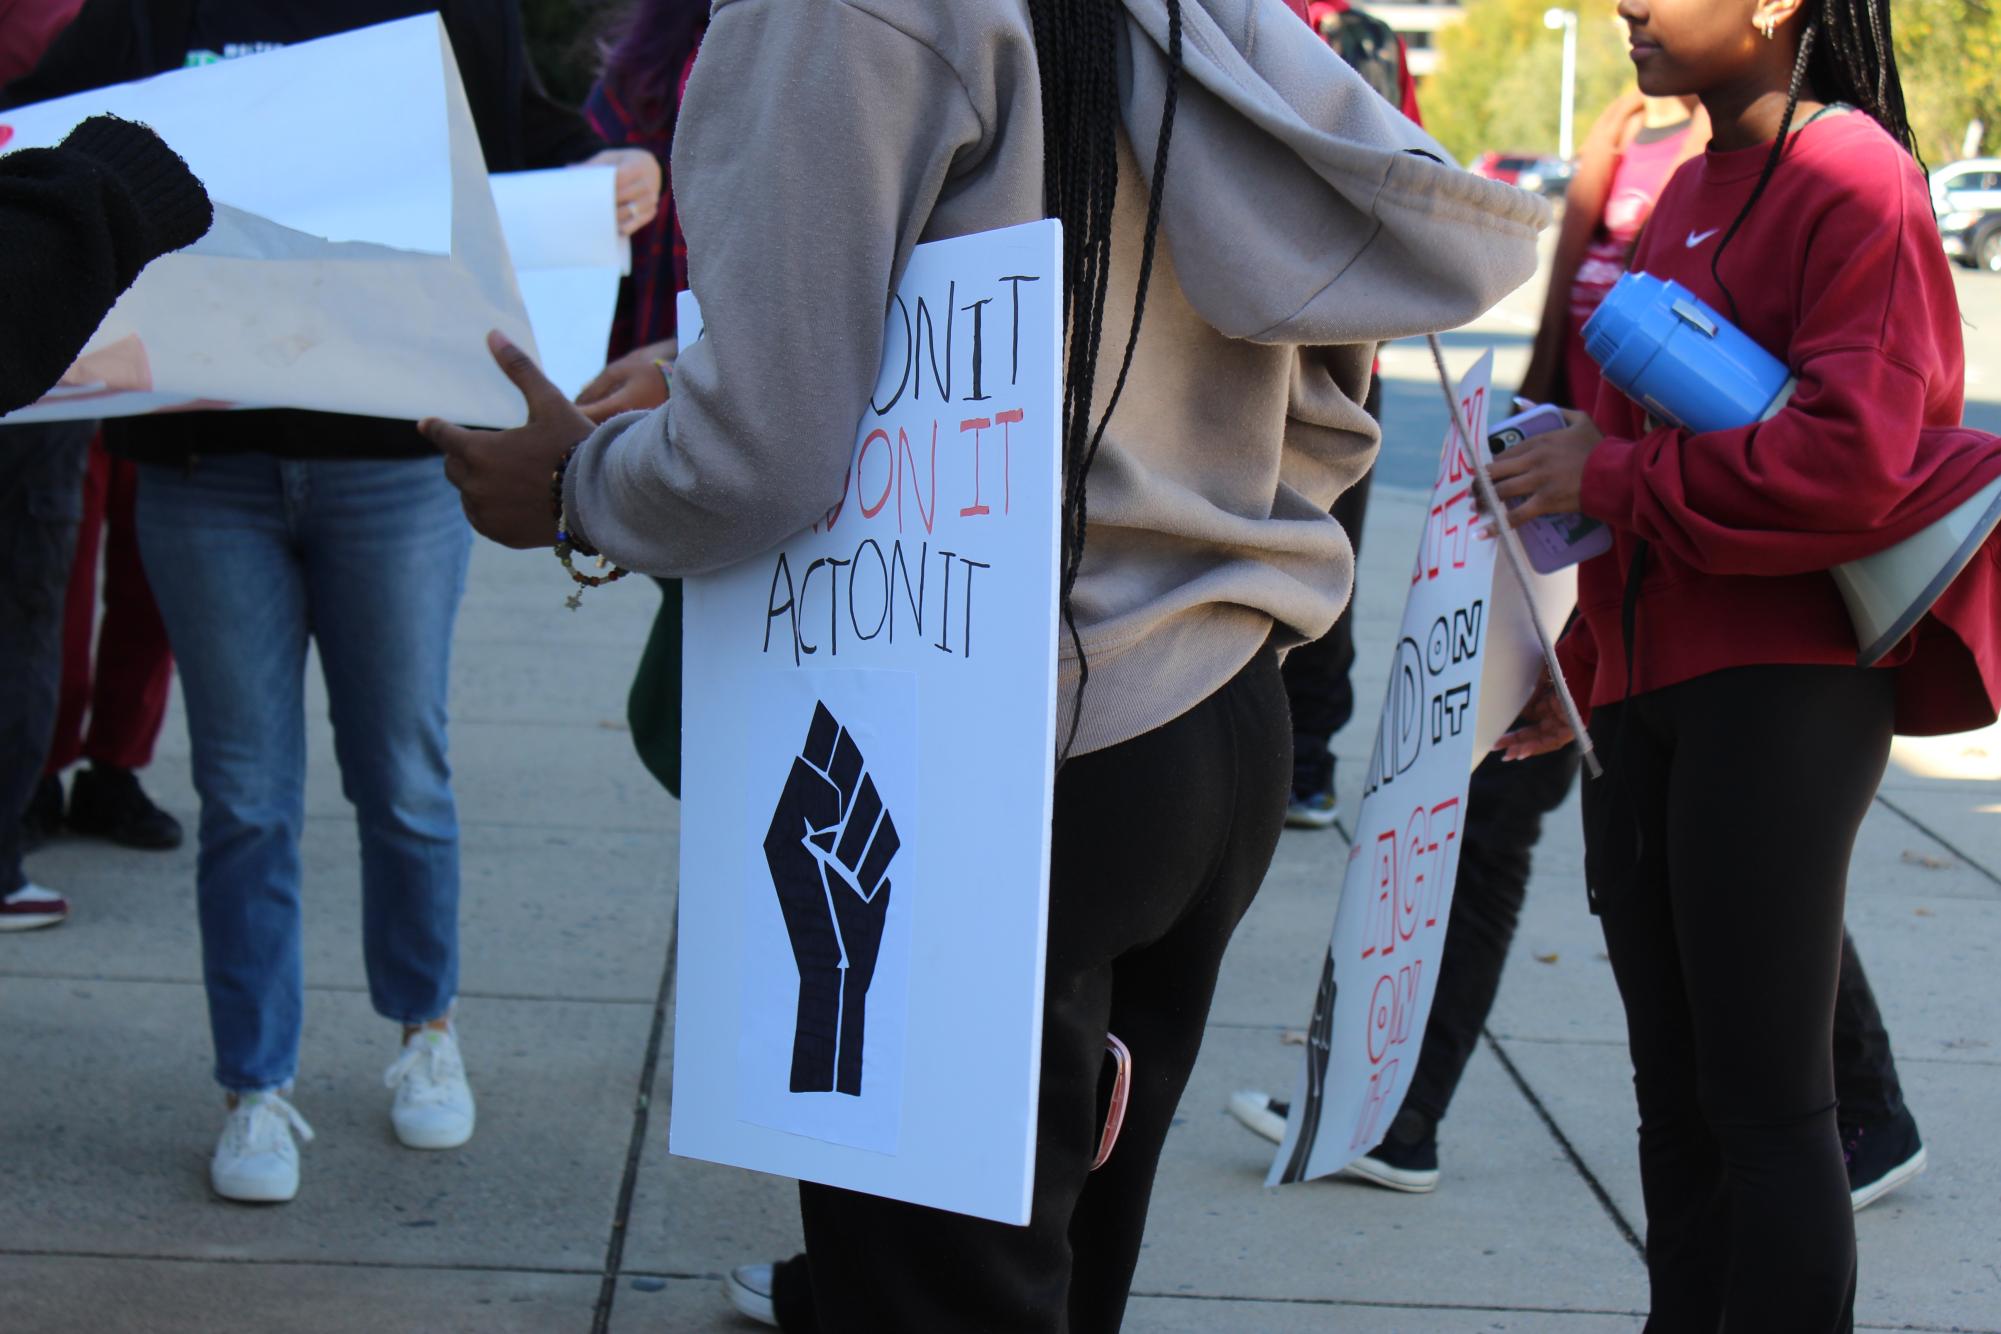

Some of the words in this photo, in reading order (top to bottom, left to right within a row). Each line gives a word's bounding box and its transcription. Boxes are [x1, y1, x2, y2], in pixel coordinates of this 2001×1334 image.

[961, 275, 1040, 400] IT
[960, 408, 1024, 517] IT
[763, 552, 850, 667] ACT
[849, 538, 927, 644] ON
[934, 551, 991, 658] IT
[1427, 600, 1483, 676] ON
[1431, 682, 1471, 745] IT
[1362, 797, 1459, 960] ACT
[1367, 960, 1422, 1065] ON
[1350, 1058, 1399, 1150] IT
